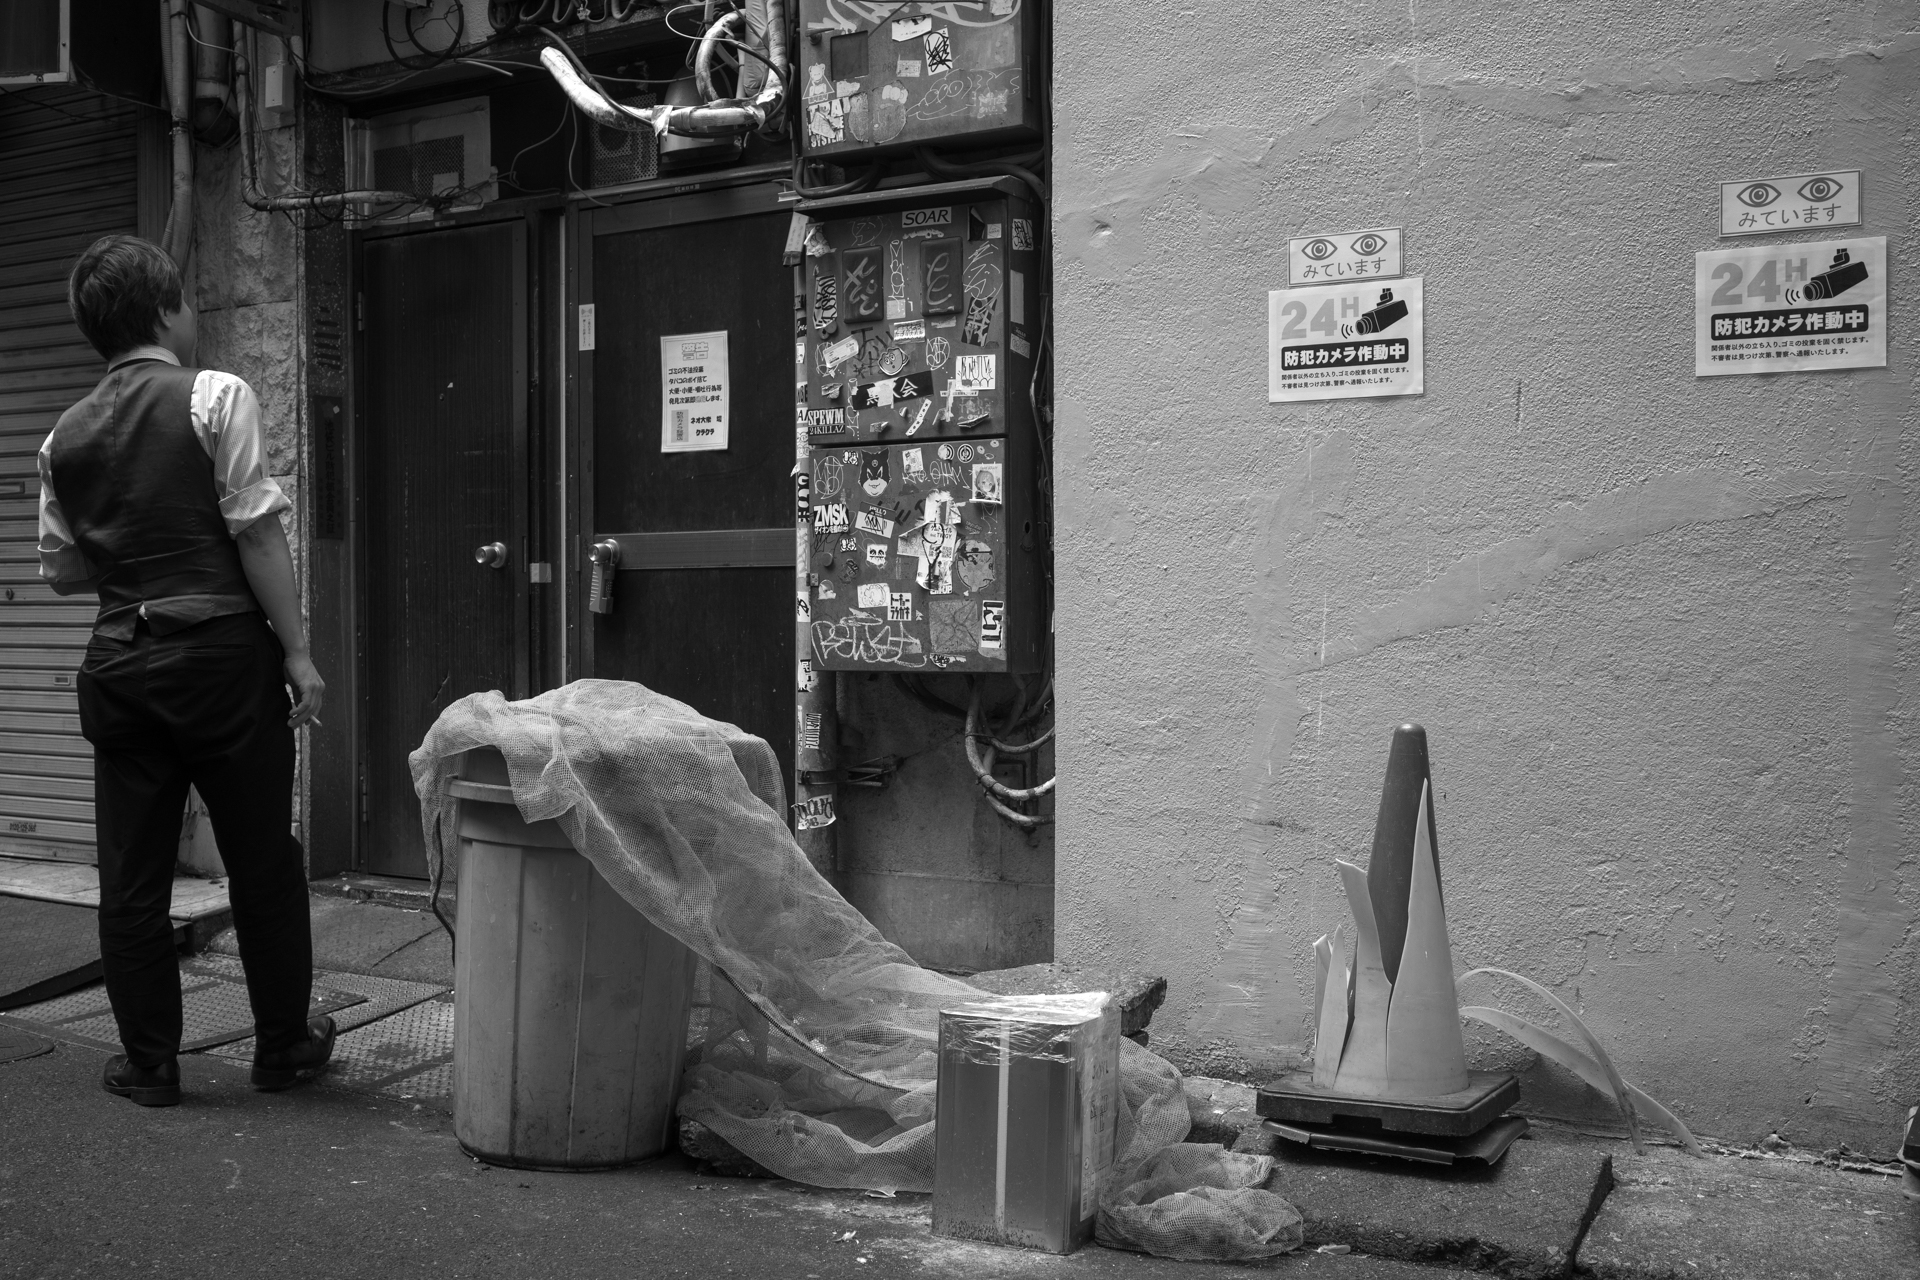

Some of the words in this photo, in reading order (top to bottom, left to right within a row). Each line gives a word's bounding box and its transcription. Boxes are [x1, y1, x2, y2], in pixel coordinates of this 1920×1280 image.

[903, 208, 951, 226] SOAR
[1738, 203, 1842, 227] みています
[1303, 256, 1387, 279] みています
[1711, 257, 1807, 307] 24H
[1281, 296, 1359, 340] 24H
[1714, 310, 1865, 337] 防犯カメラ作動中
[1711, 336, 1869, 352] 関係者以外の立ち入り、ゴミの投棄を固く禁じます。
[1284, 343, 1406, 367] 防犯カメラ作動中
[1711, 347, 1849, 362] 不審者は見つけ次第、警察へ通報いたします。
[668, 366, 704, 375] ゴミの不法投棄
[1281, 366, 1410, 381] 関係者以外の立ち入り、ゴミの投棄を固く禁じます。
[668, 375, 708, 385] タバコのポイ捨て
[1281, 376, 1393, 390] 不審者は見つけ次第、警察へ通報いたします。
[808, 408, 844, 426] SPEWM
[695, 428, 715, 437] クラクラ
[813, 503, 849, 527] ZMSK
